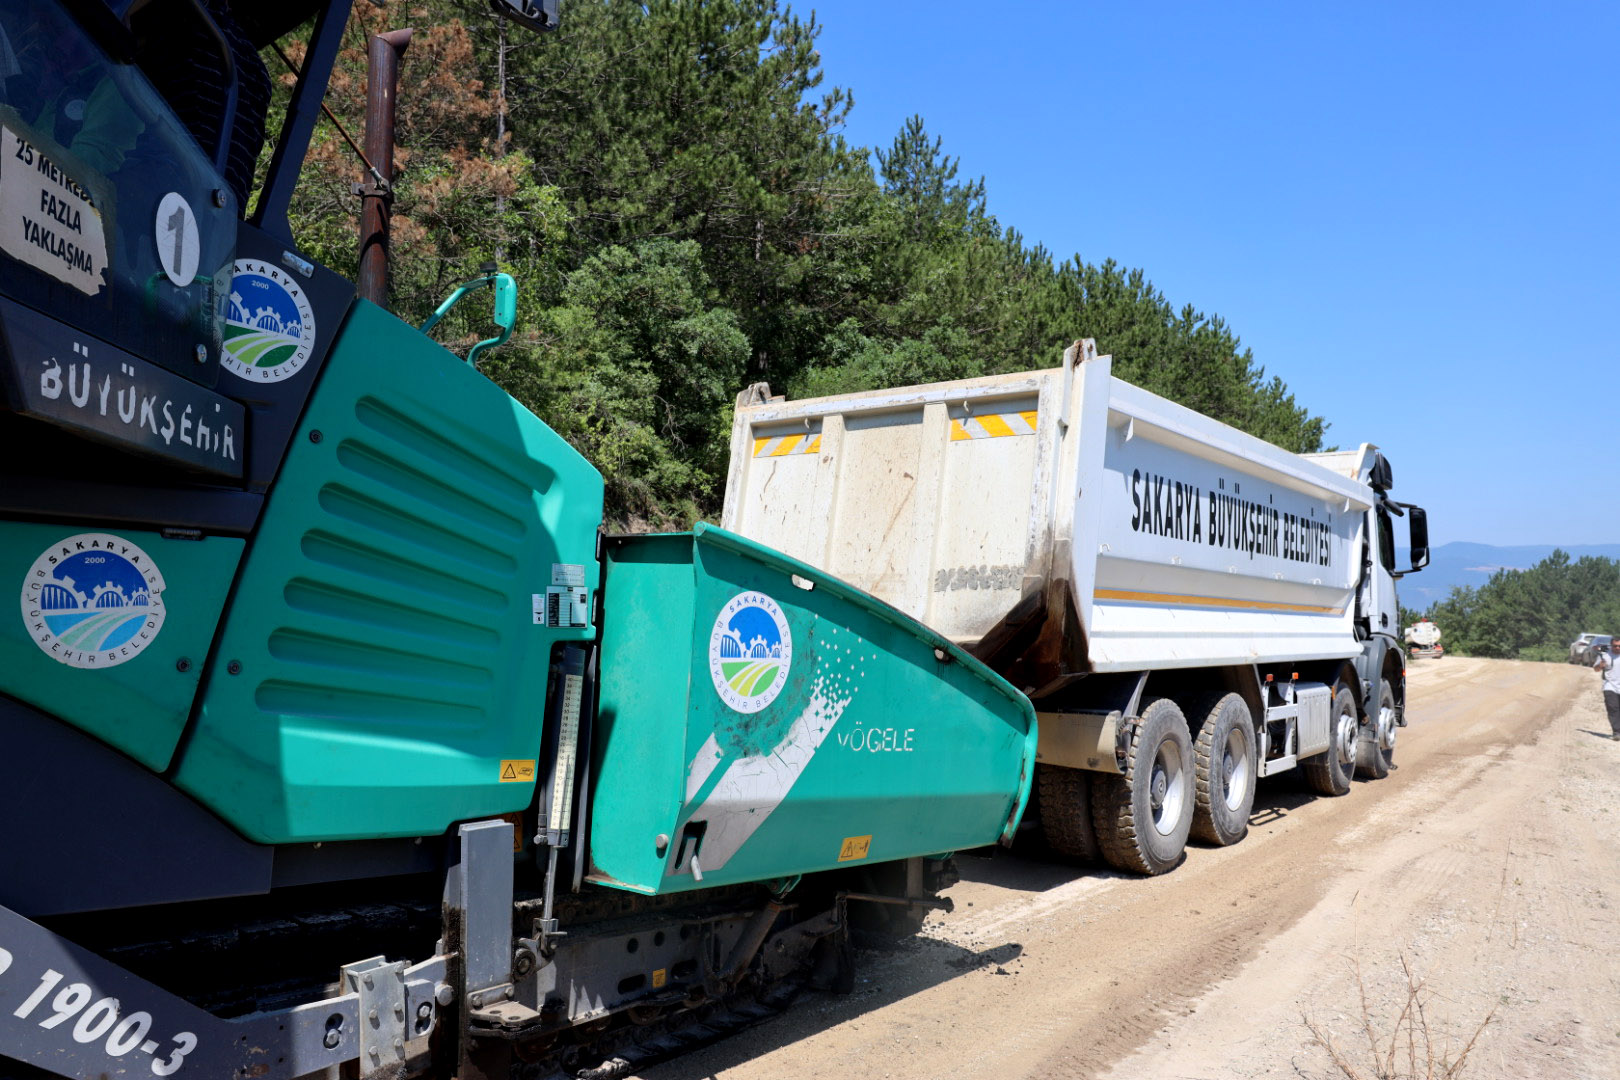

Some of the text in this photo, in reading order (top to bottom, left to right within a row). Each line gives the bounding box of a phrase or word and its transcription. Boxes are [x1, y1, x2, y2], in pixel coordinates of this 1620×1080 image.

[16, 138, 34, 166] 25
[40, 188, 82, 235] FAZLA
[22, 215, 93, 276] YAKLAŞMA
[168, 205, 185, 277] 1
[251, 280, 269, 290] 2000
[40, 342, 236, 461] BÜYÜKŞEHİR
[1131, 467, 1332, 568] SAKARYA BÜYÜKŞEHİR BELEDİYESİ
[48, 539, 141, 564] SAKARYA
[28, 569, 96, 663] BÜYÜKŞEHİR
[729, 595, 777, 616] SAKARYA
[837, 721, 915, 753] VÖGELE
[13, 968, 198, 1076] 1900-3
